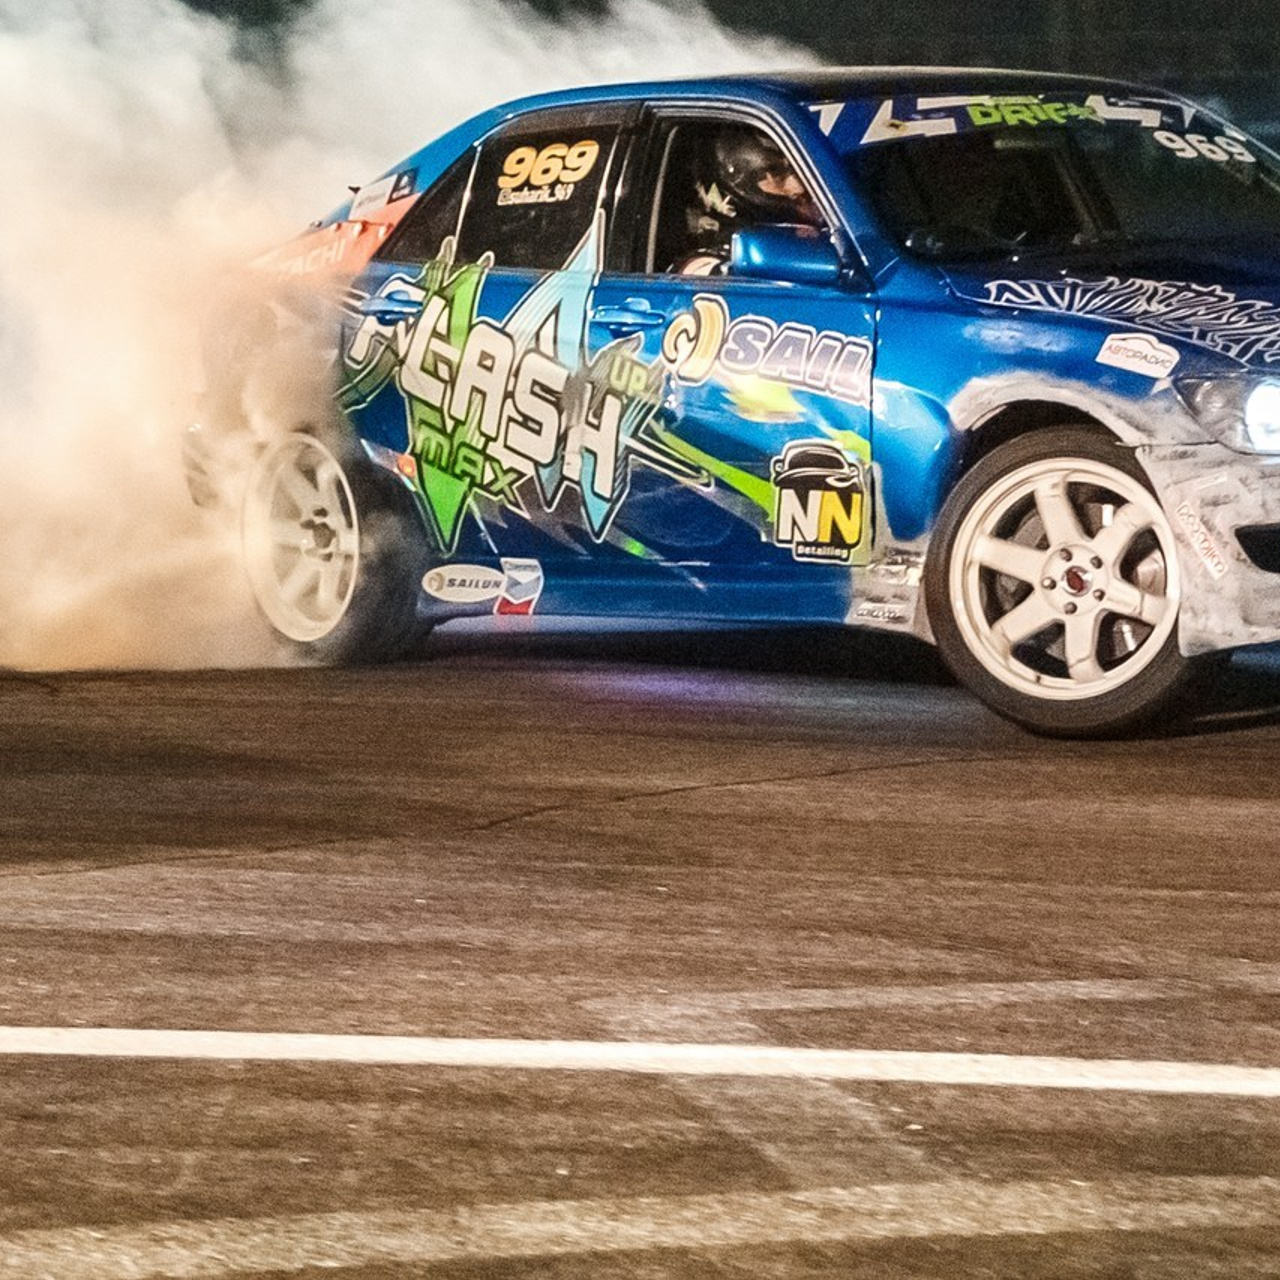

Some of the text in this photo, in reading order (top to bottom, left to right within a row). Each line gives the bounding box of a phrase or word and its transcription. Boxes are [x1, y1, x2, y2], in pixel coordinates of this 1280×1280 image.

[498, 140, 599, 189] 969
[1153, 130, 1256, 163] 969
[778, 488, 861, 544] NN
[447, 578, 501, 589] SAILUN
